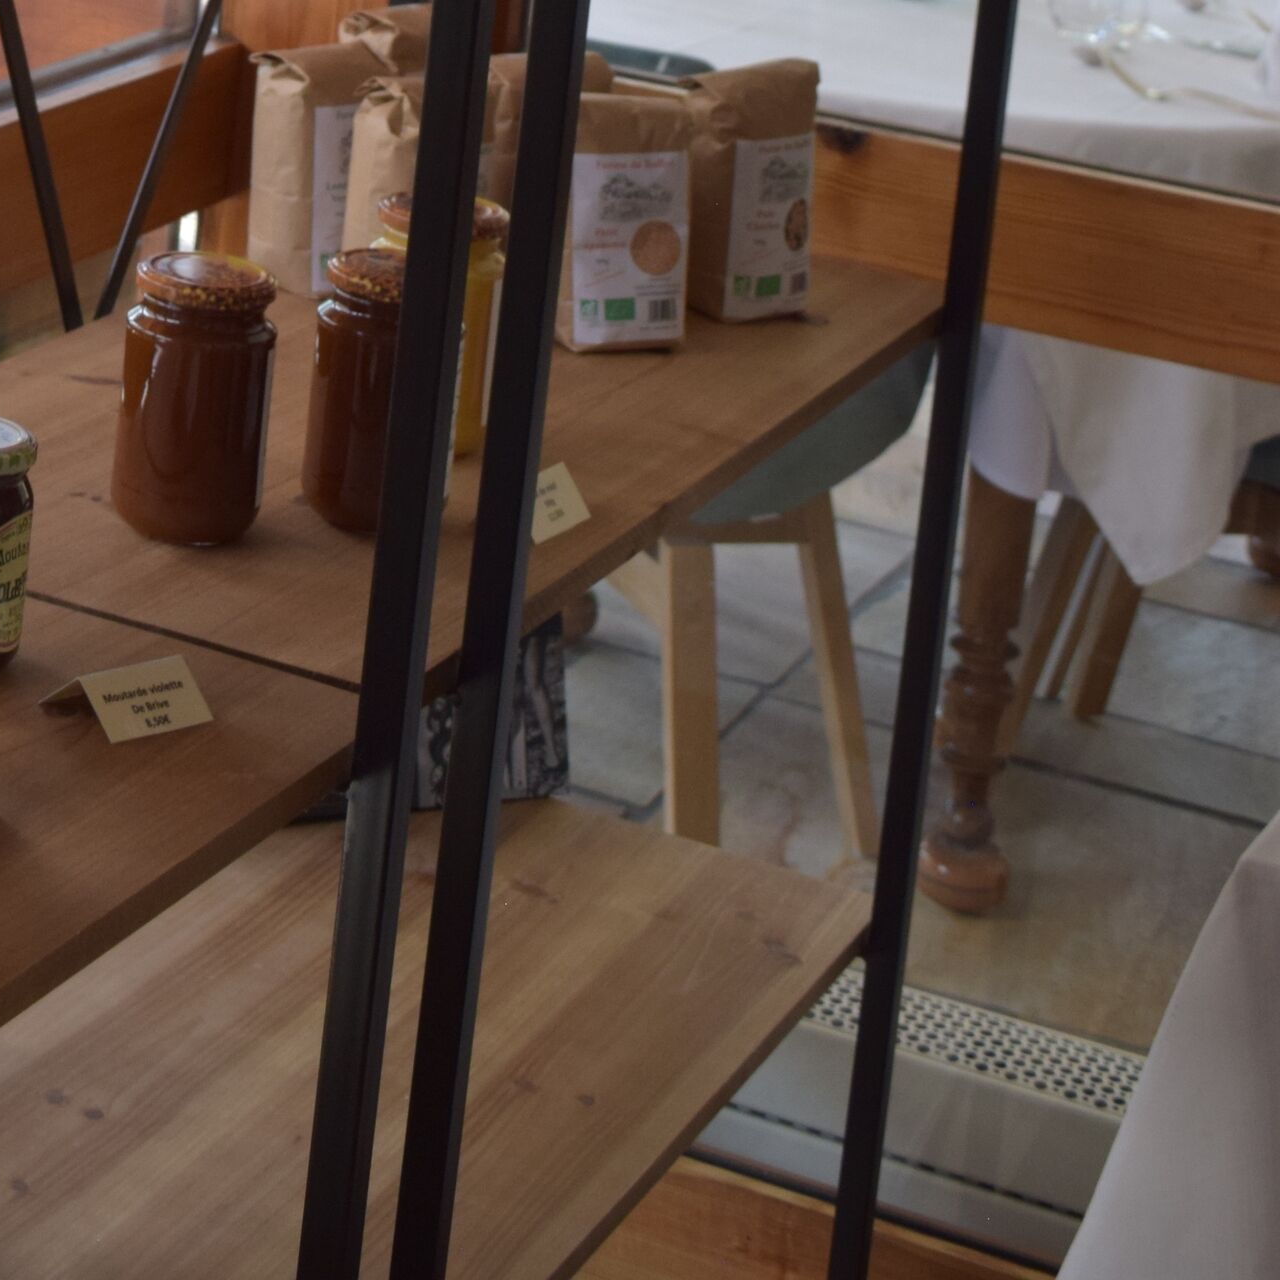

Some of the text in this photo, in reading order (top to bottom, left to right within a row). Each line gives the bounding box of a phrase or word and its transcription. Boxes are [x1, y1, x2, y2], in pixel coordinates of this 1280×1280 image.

[101, 680, 184, 705] Moutarde violette
[131, 699, 170, 715] De Brive
